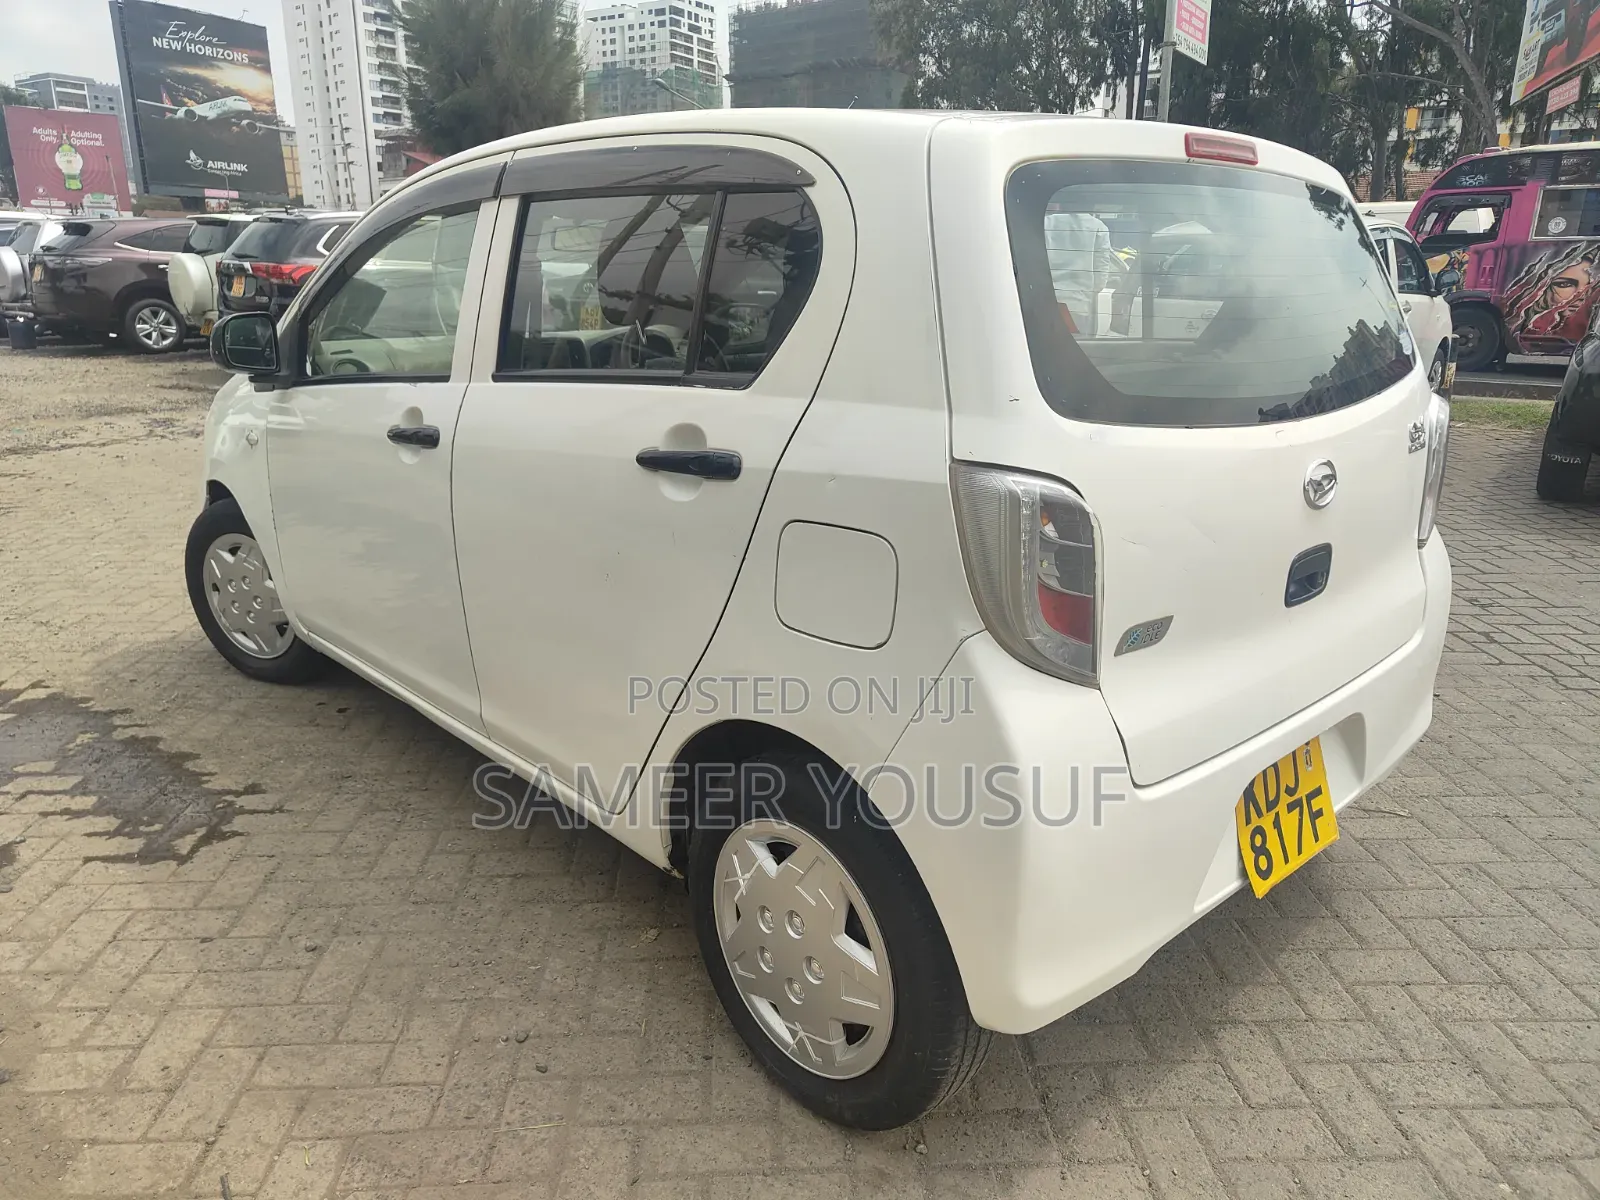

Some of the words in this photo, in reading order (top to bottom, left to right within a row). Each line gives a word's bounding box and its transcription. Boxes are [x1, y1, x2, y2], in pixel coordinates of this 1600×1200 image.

[165, 21, 227, 47] Explore
[152, 36, 182, 51] NEW
[186, 42, 249, 63] HORIZONS
[32, 127, 57, 136] Adults
[71, 130, 102, 140] Adulting
[40, 134, 60, 144] Only.
[70, 137, 105, 147] Optional.
[207, 160, 249, 172] AIRLINK
[1243, 749, 1300, 827] KDJ
[1250, 784, 1324, 881] 817F
